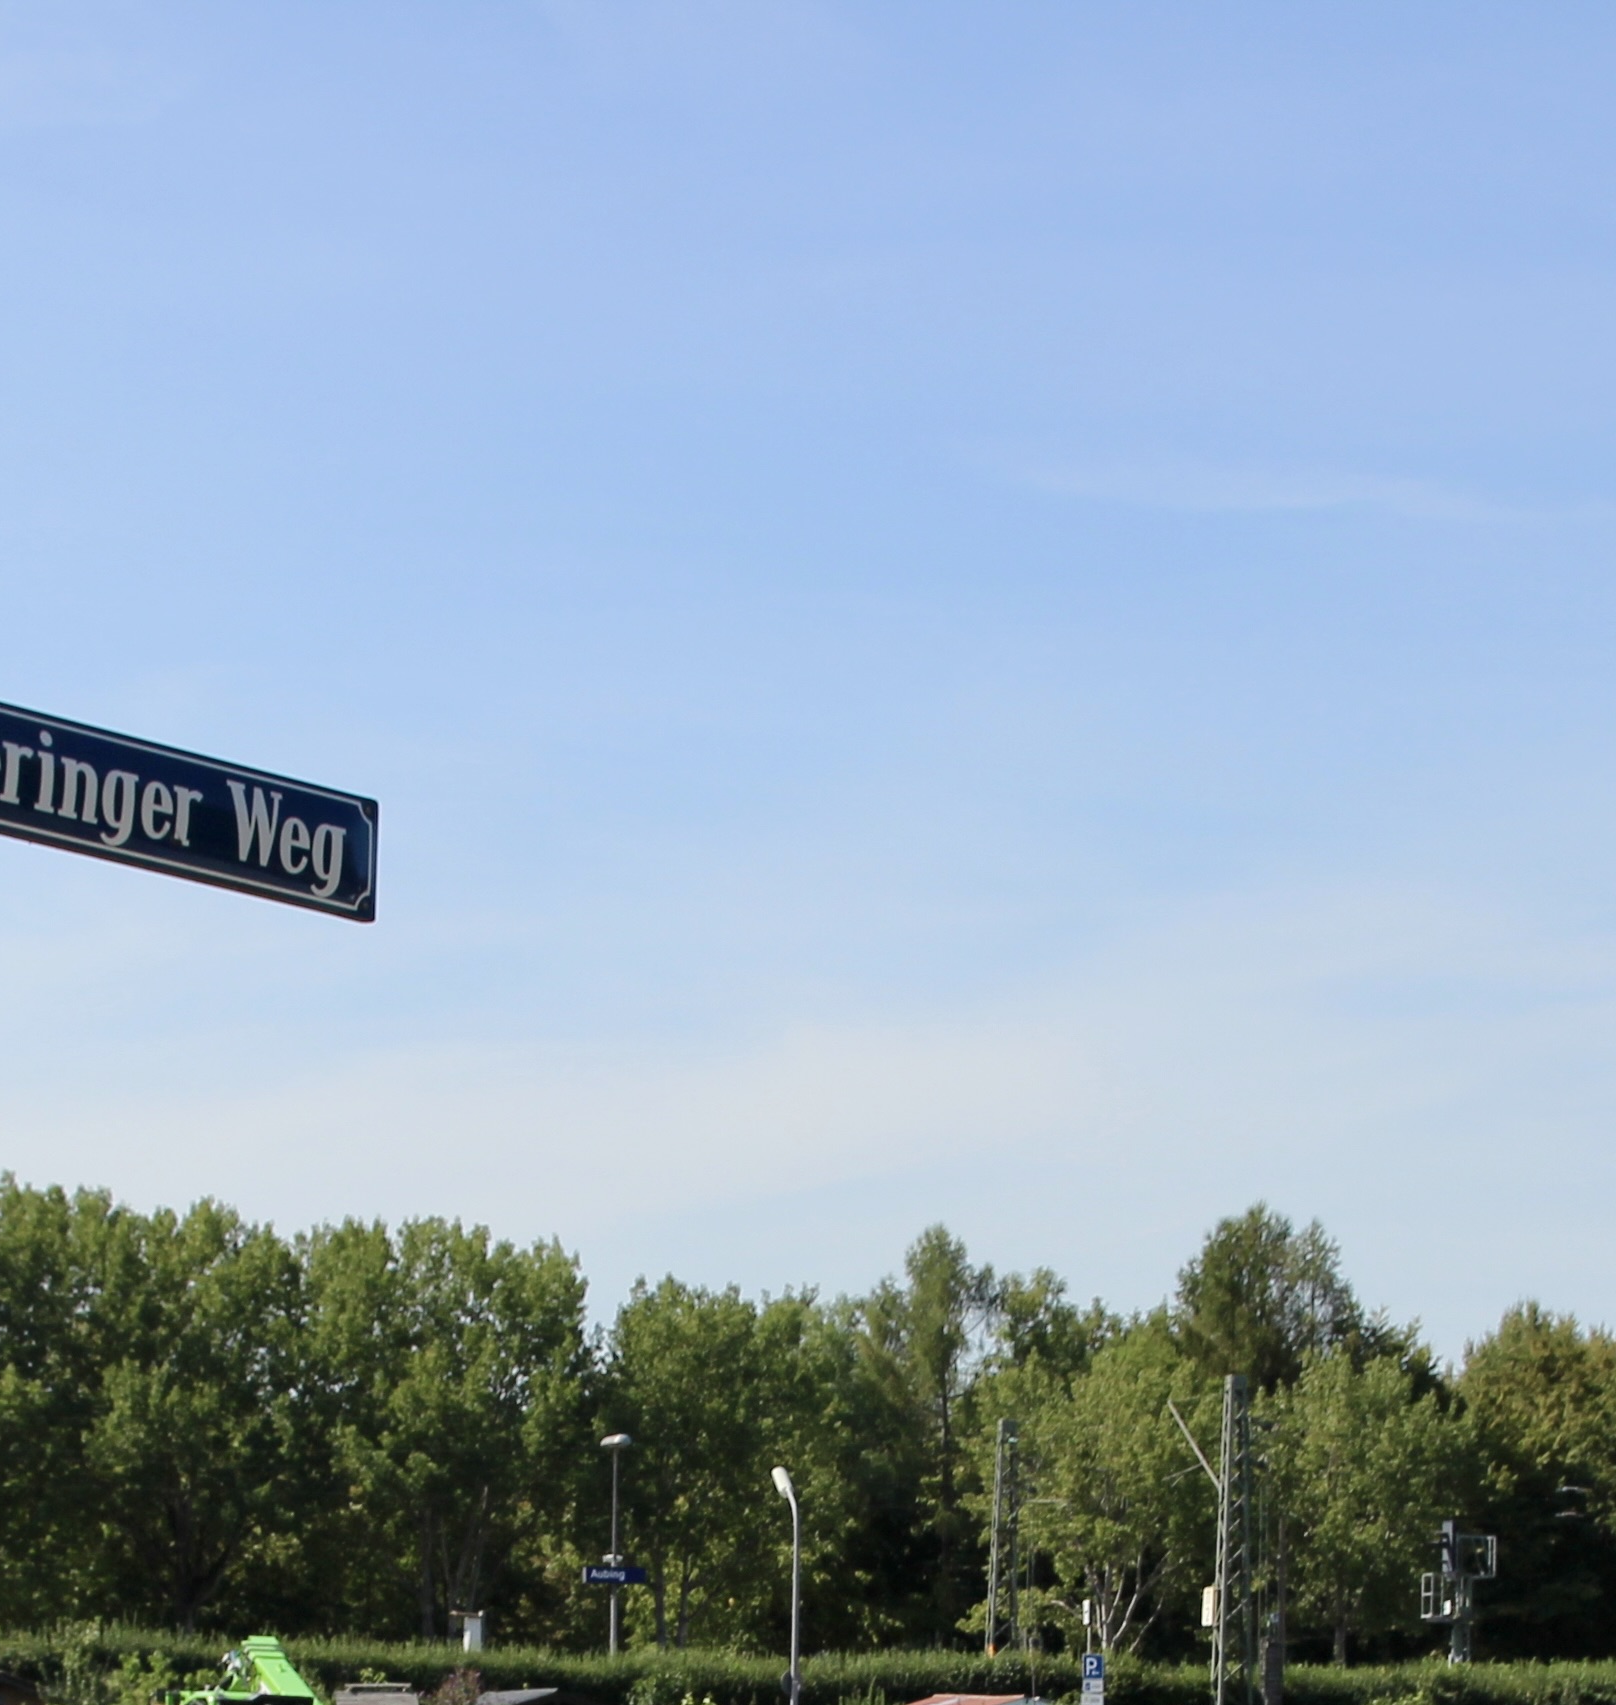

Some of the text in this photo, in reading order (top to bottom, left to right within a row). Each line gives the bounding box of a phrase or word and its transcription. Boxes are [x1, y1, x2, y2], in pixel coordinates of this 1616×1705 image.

[225, 779, 347, 898] Weg
[590, 1568, 626, 1582] Aubing
[1086, 1657, 1098, 1677] P
